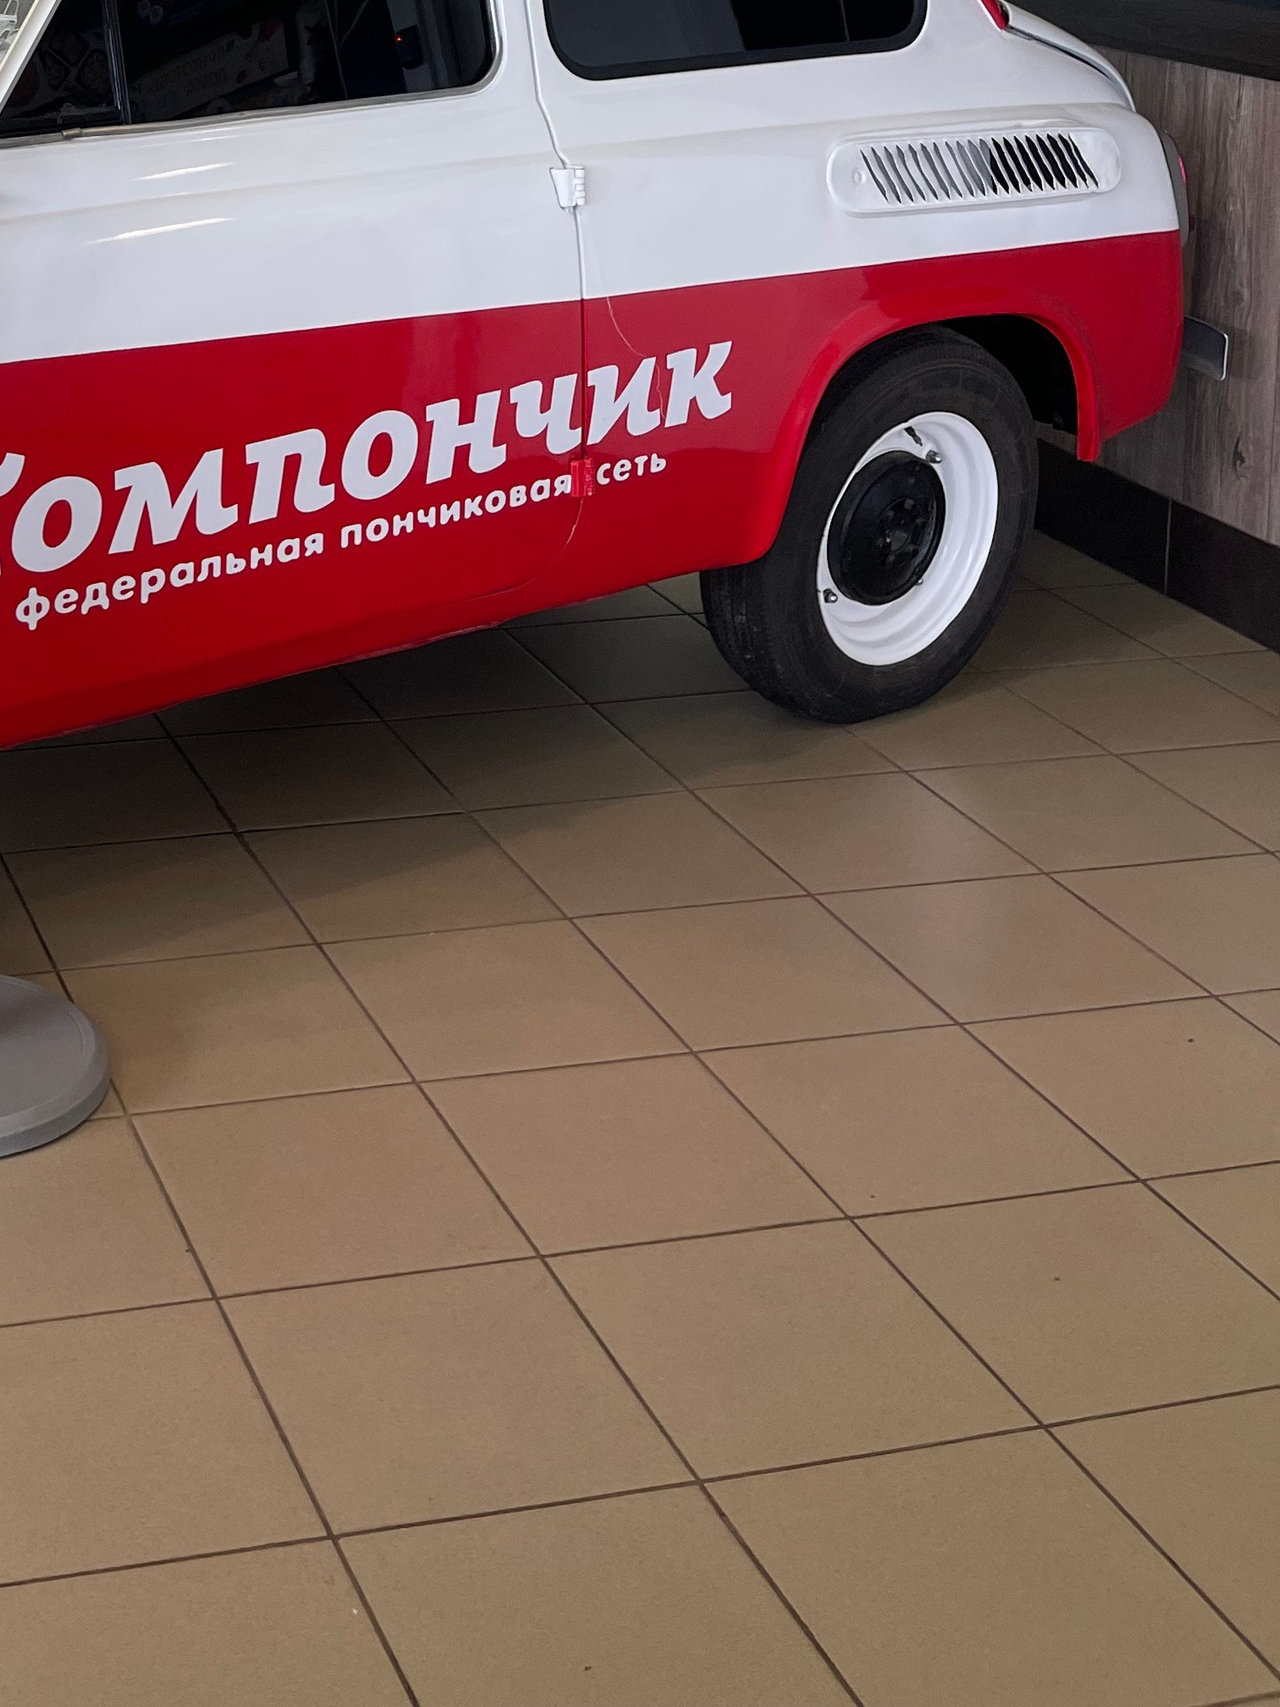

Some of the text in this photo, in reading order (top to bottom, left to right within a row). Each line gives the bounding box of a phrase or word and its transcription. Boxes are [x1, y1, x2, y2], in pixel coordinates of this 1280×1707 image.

[14, 449, 668, 631] федеральная пончиковая сеть
